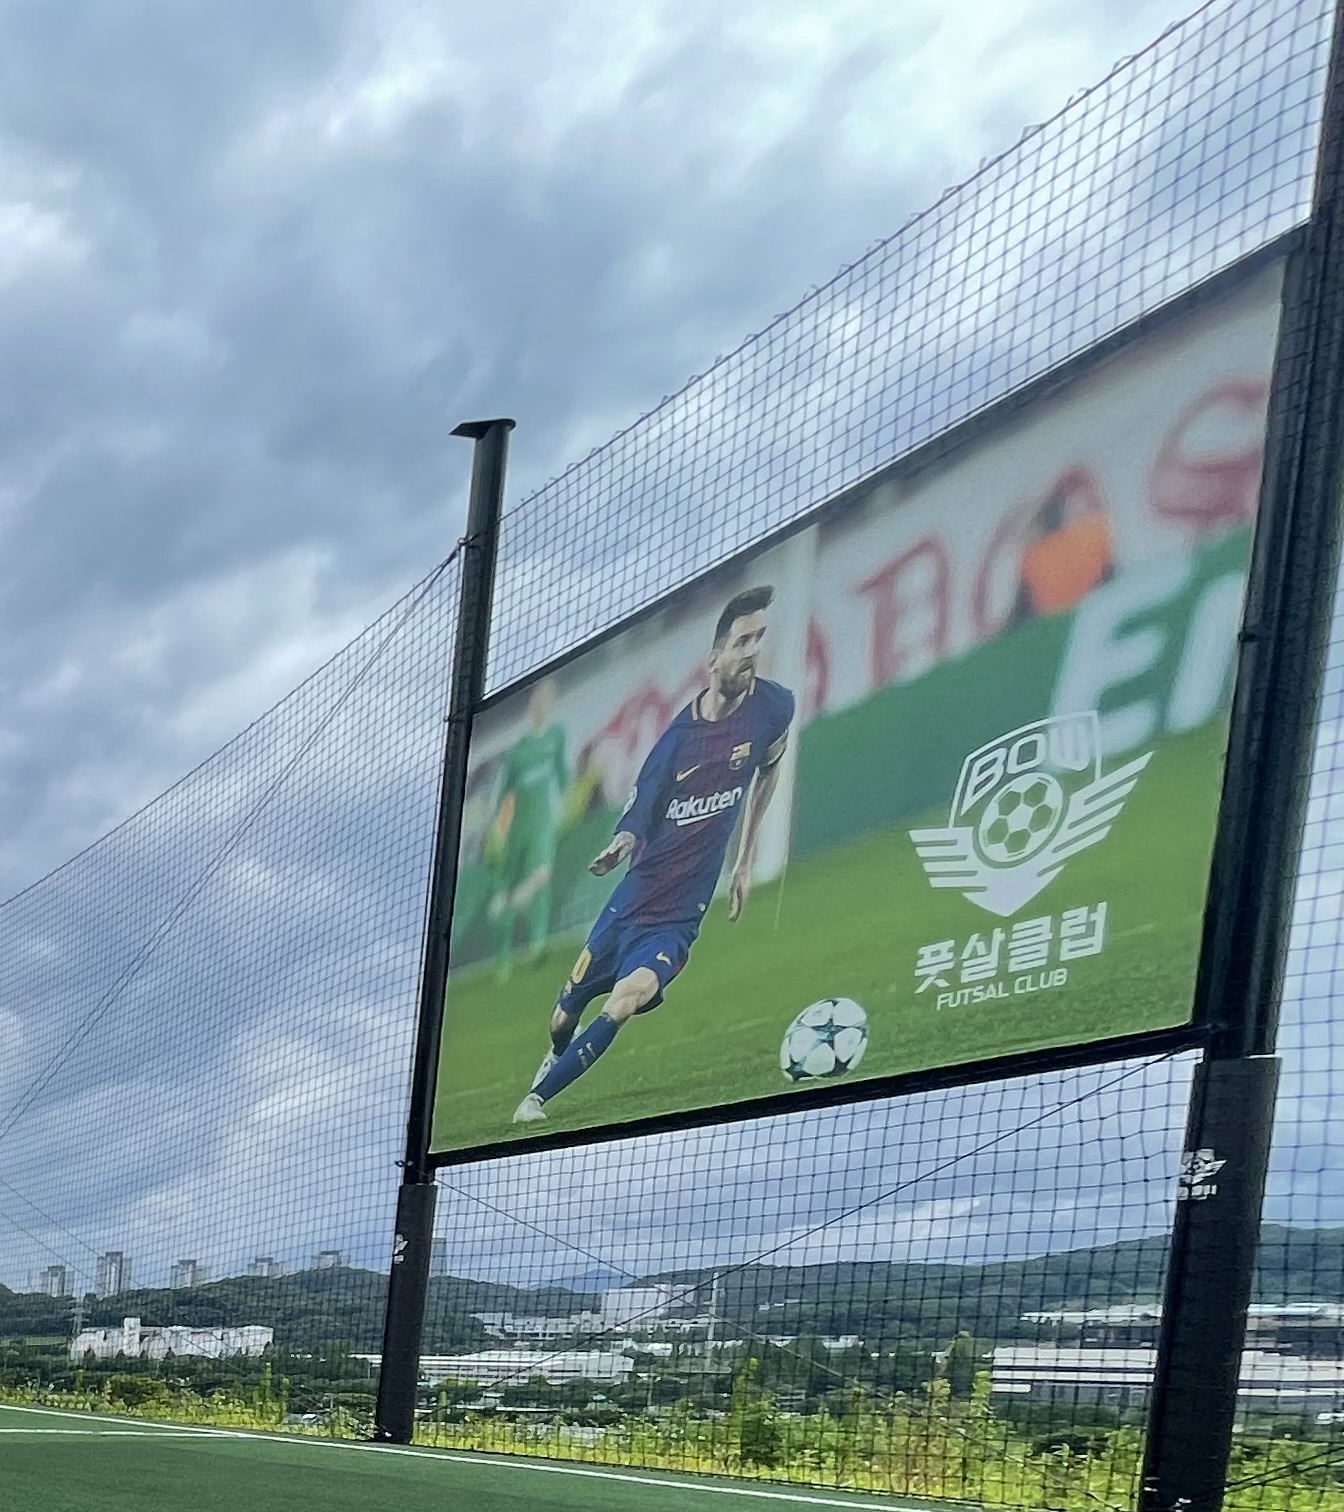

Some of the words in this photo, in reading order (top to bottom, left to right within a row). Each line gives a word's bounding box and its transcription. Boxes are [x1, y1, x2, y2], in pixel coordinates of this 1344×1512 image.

[665, 786, 743, 820] Rakuten
[914, 901, 1107, 994] 풋살클럽
[936, 981, 1010, 1011] FUTSAL
[1014, 968, 1068, 994] CLUB
